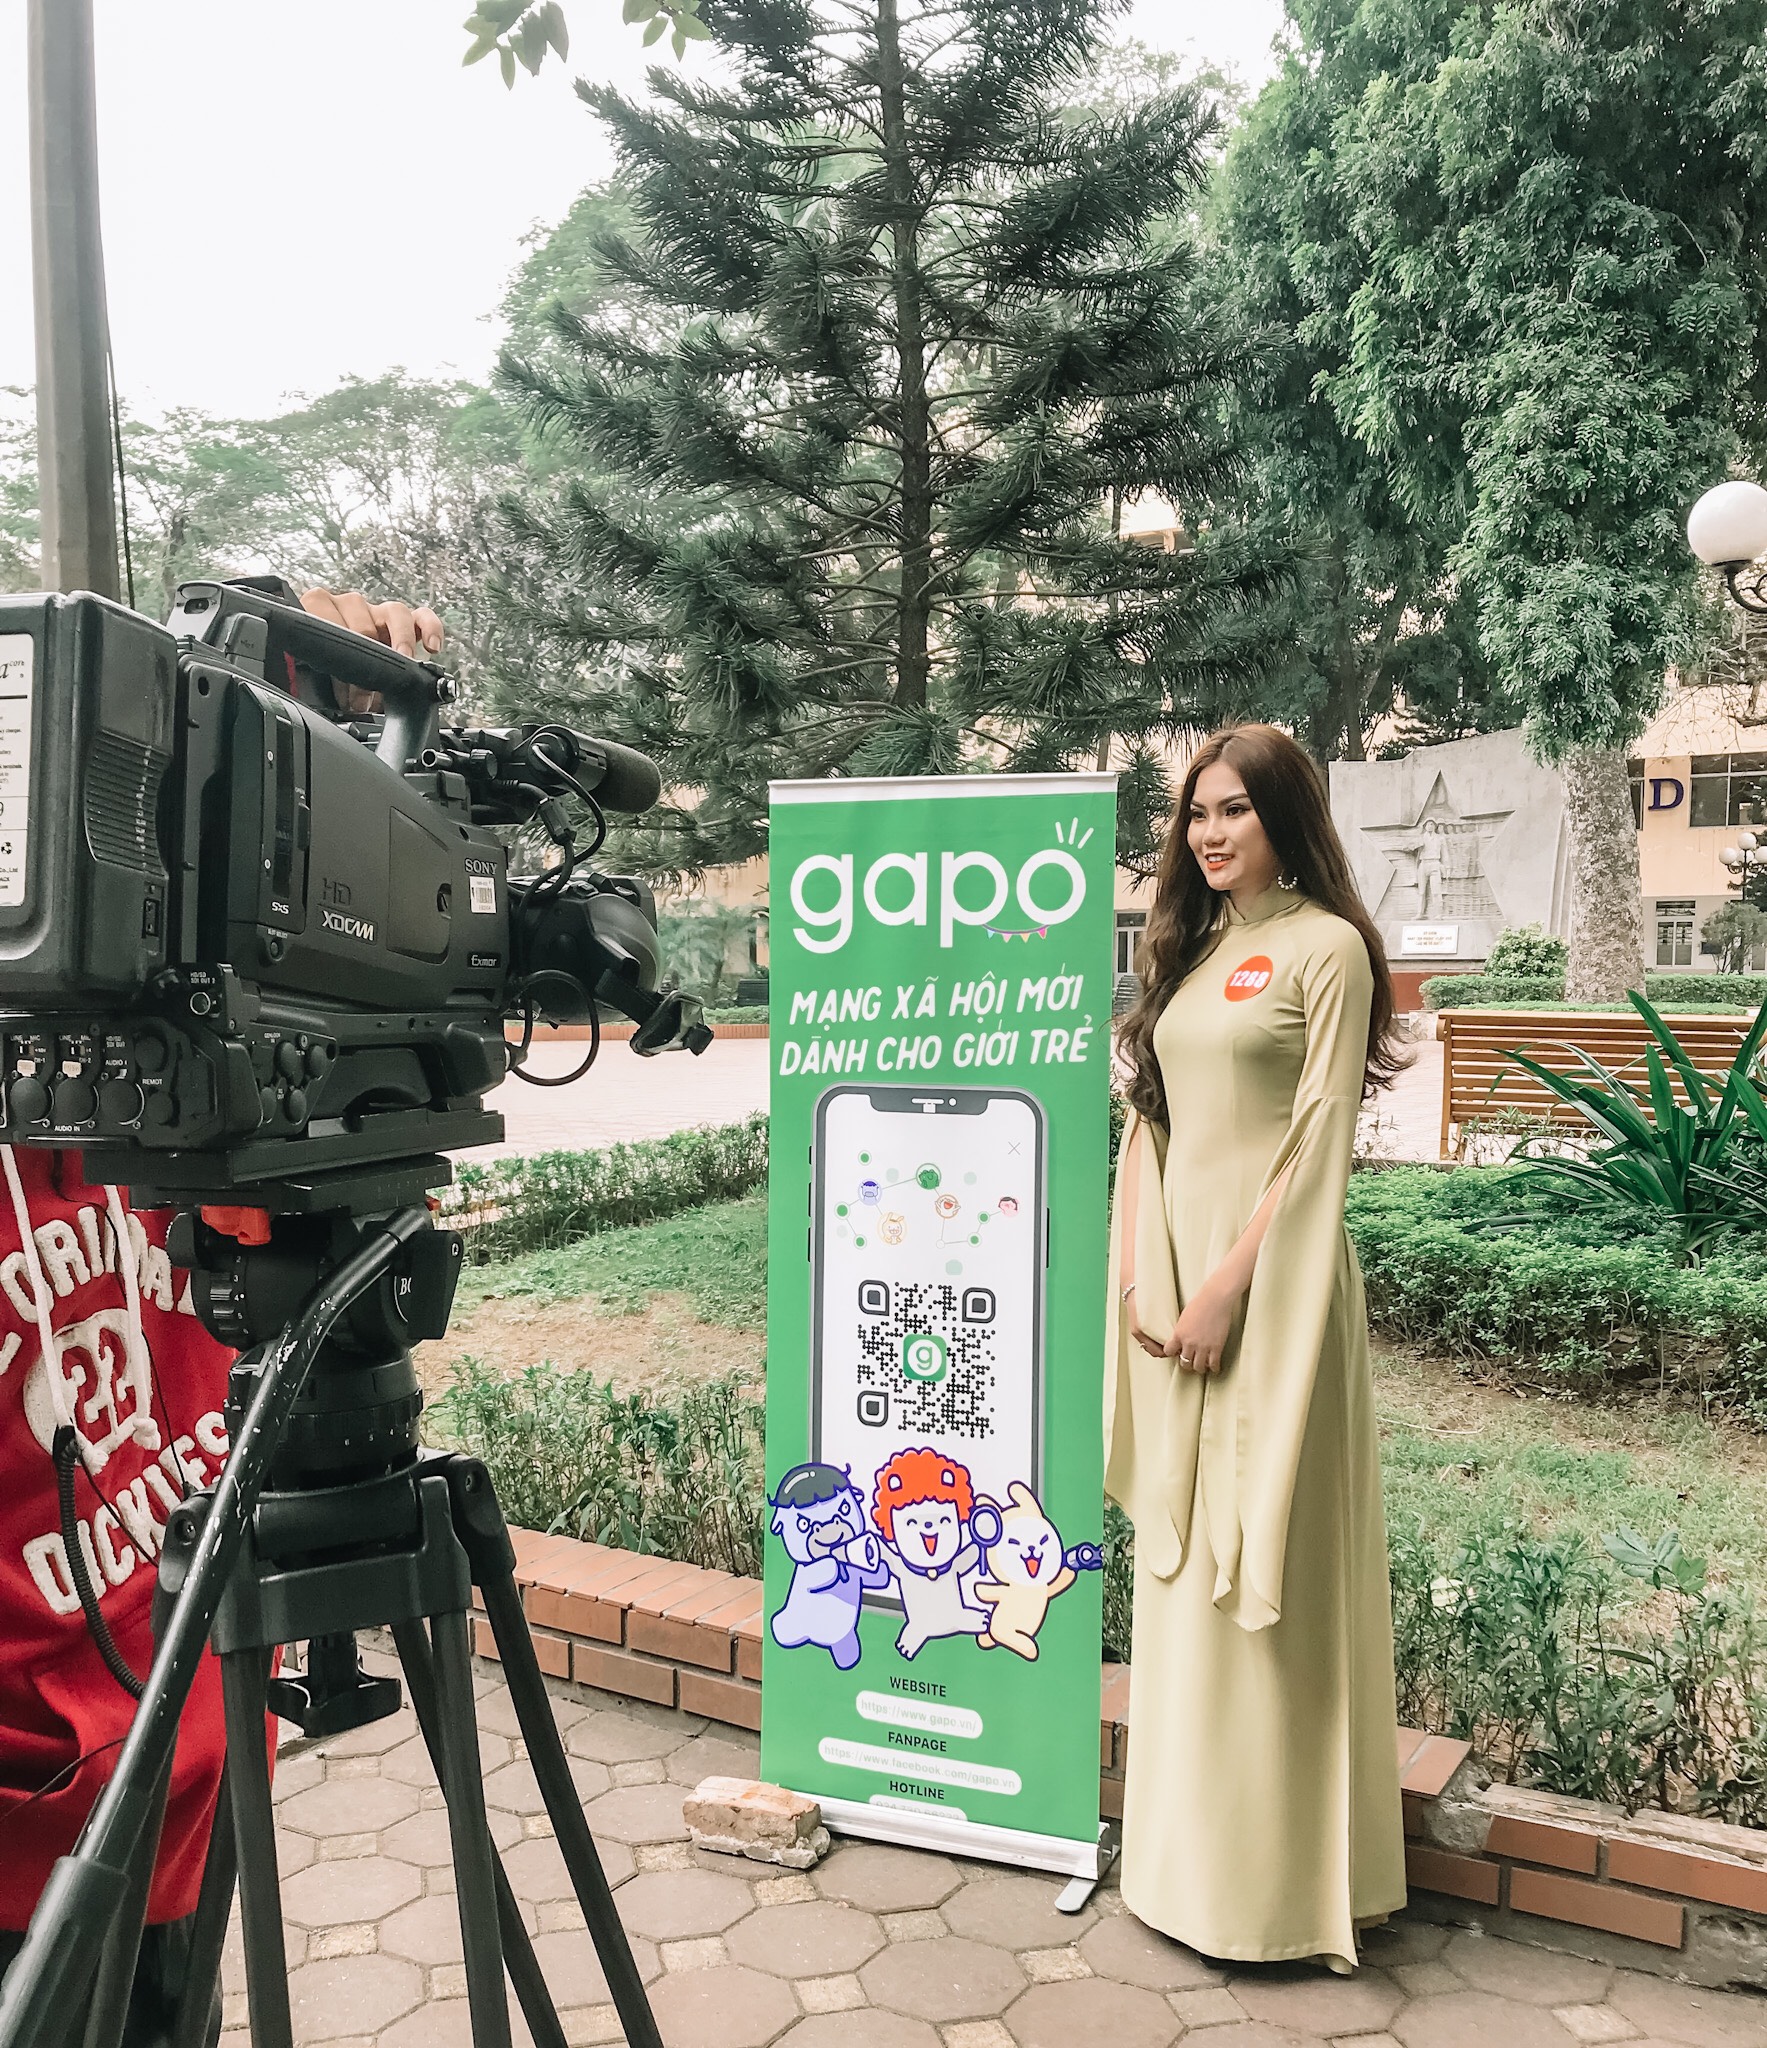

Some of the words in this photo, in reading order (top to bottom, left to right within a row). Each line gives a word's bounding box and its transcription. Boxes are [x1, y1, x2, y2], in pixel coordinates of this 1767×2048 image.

[1648, 778, 1684, 811] D
[465, 858, 498, 875] SONY
[790, 849, 1087, 954] gapo
[322, 910, 374, 941] XDCAM
[471, 954, 497, 967] Exmor
[789, 986, 882, 1031] MẠNG
[891, 976, 939, 1019] XÃ
[949, 971, 1008, 1024] HỘI
[1016, 963, 1084, 1013] MỚI
[876, 1035, 942, 1071] CHO
[953, 1019, 1019, 1067] GIỚI
[1030, 1014, 1093, 1064] TRẺ
[889, 1676, 947, 1698] WEBSITE
[861, 1698, 977, 1733] https://www.gapo.vn/
[888, 1731, 947, 1752] FANPAGE
[824, 1744, 1015, 1789] https://www.facebook.com/gapo.vn
[889, 1780, 945, 1800] HOTLINE
